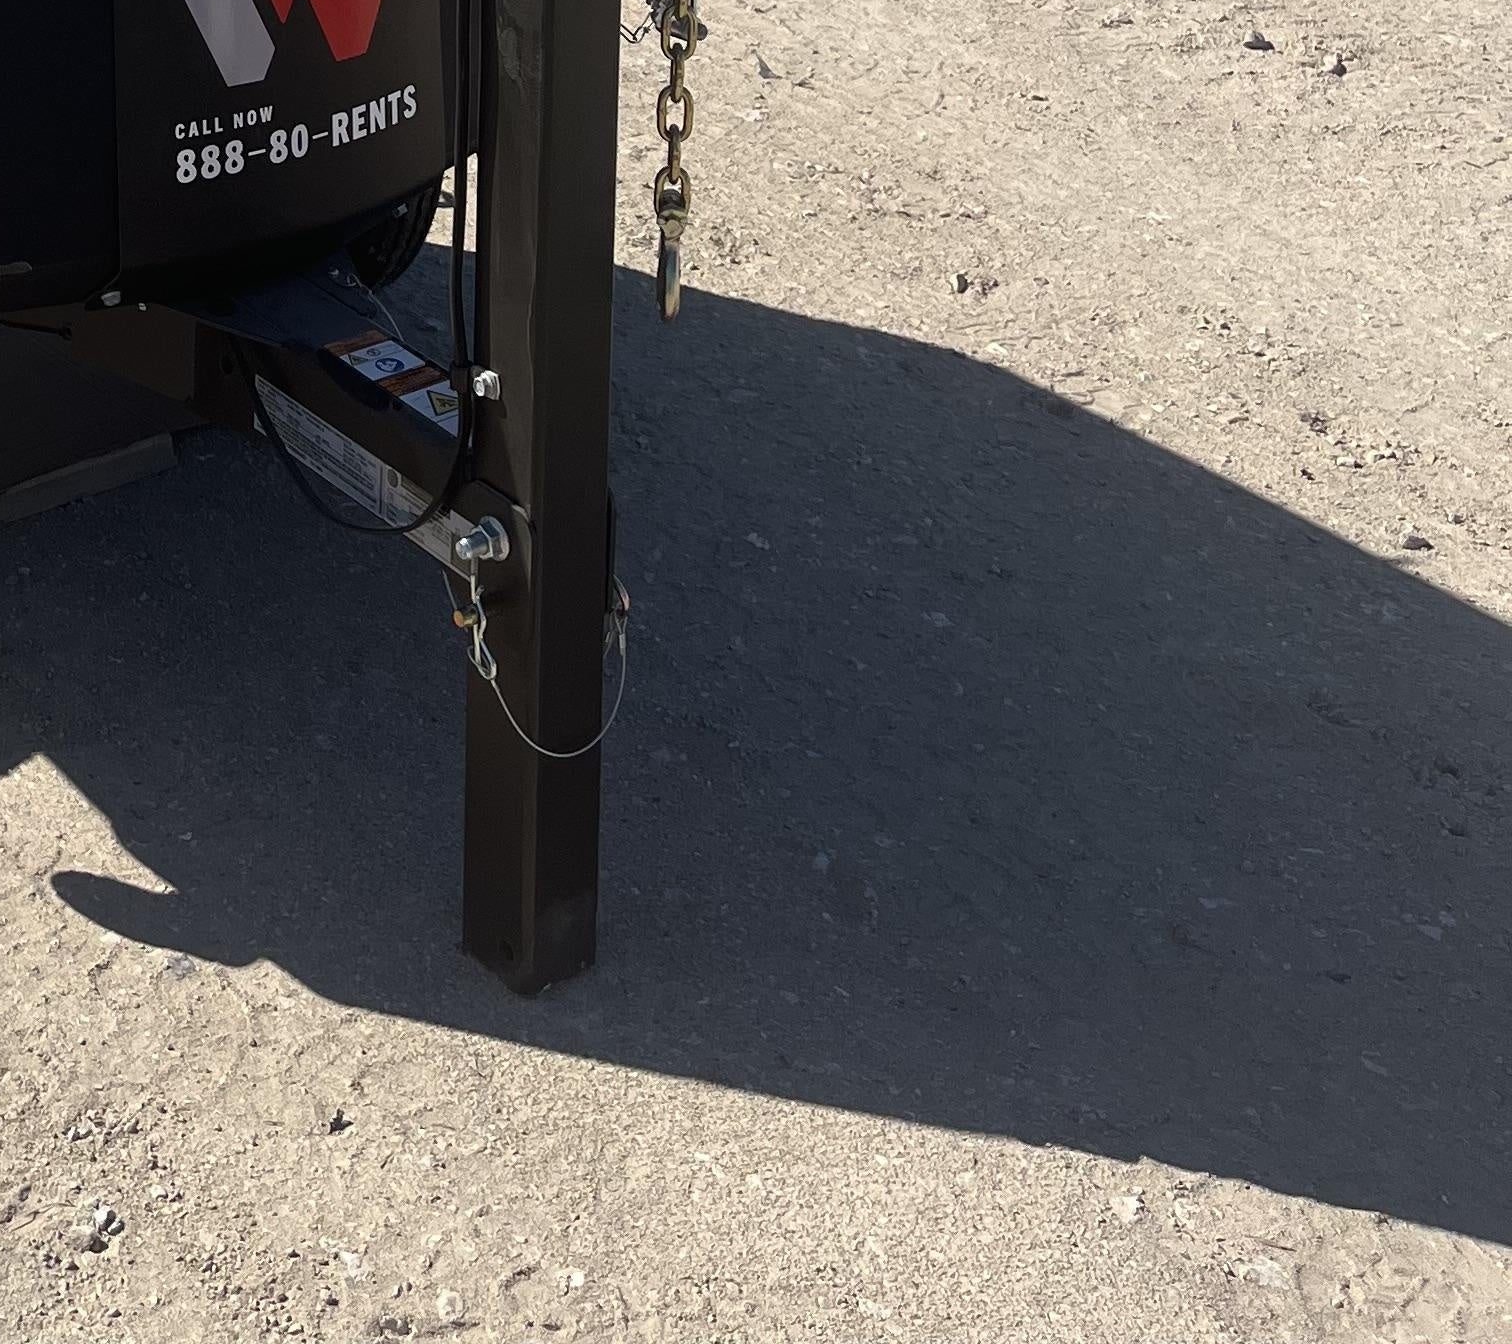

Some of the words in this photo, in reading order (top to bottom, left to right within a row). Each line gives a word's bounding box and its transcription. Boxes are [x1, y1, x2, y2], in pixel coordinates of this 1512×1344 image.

[175, 116, 224, 140] CALL
[233, 105, 274, 127] NOW
[175, 84, 418, 184] 888-80-RENTS
